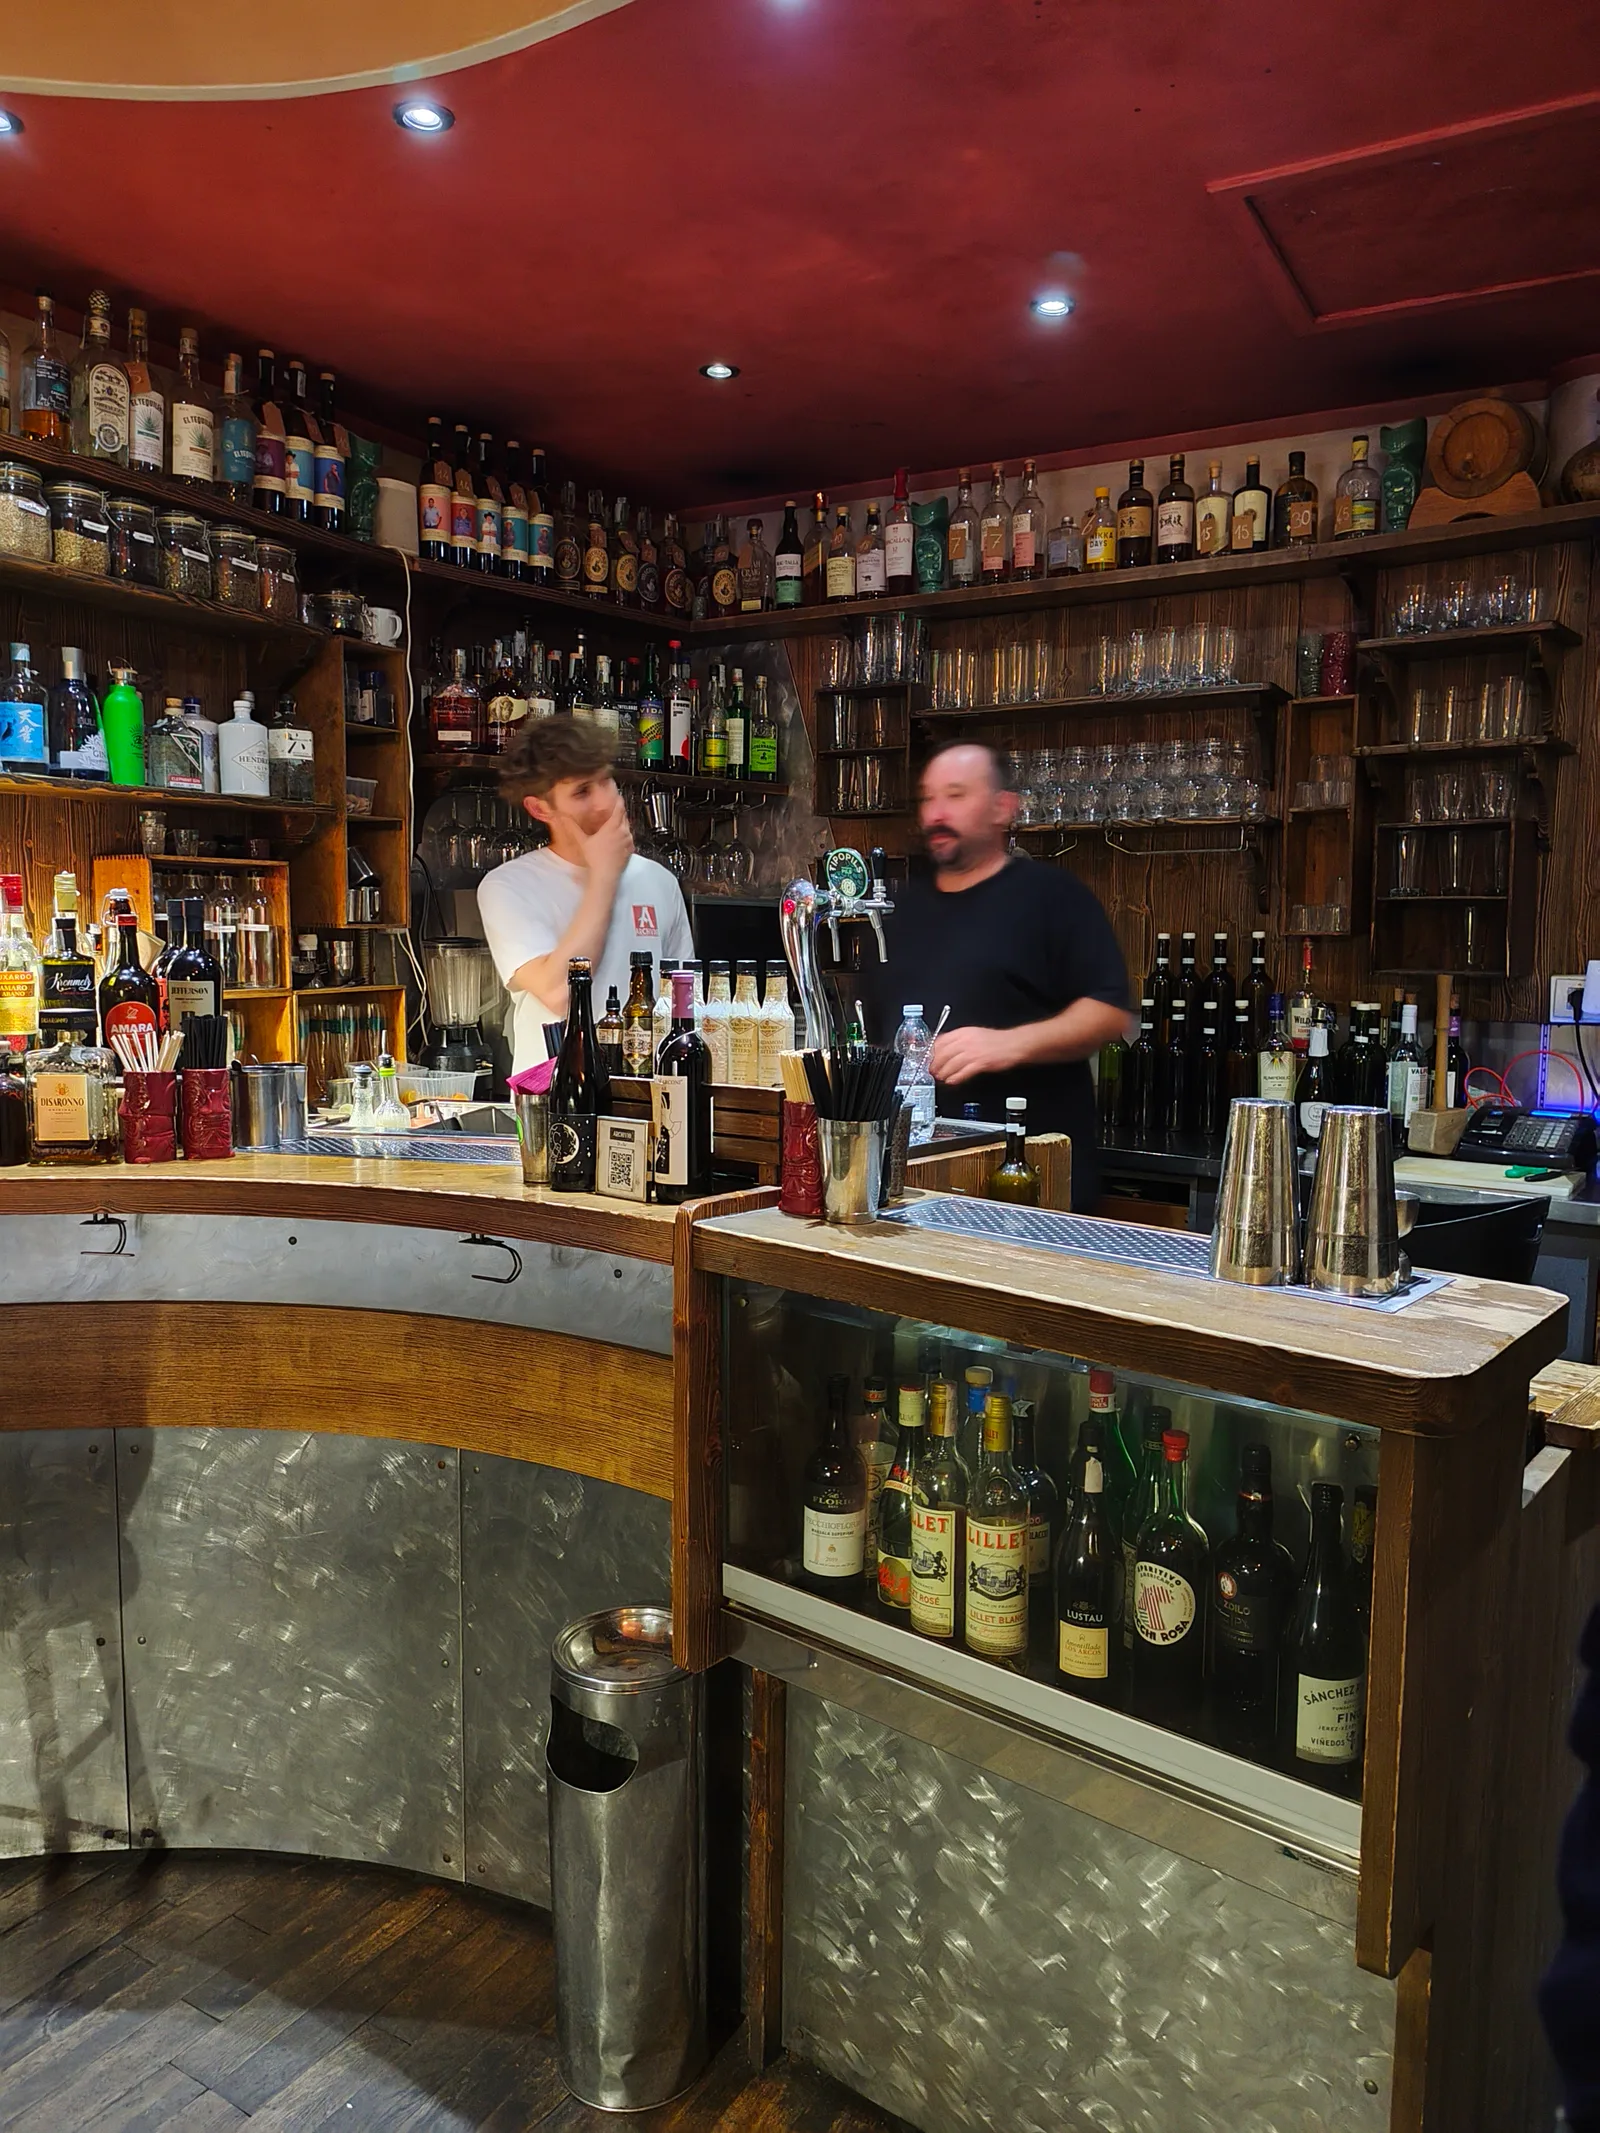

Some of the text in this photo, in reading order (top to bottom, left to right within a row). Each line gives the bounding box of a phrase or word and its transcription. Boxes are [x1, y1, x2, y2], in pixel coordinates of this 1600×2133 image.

[1291, 510, 1311, 529] 30
[1234, 524, 1250, 540] 15
[951, 537, 961, 554] 7
[990, 533, 1003, 549] 7
[829, 852, 864, 874] TIPOPILS
[0, 984, 28, 992] AMARO
[171, 986, 209, 995] JEFFERSON
[110, 1022, 155, 1034] AMARA
[40, 1098, 85, 1107] DISARONNO
[813, 1495, 856, 1505] FLORIO
[968, 1526, 1027, 1550] LILLET
[919, 1594, 940, 1606] ROSÉ
[970, 1609, 1024, 1625] LILLET BLANC
[1066, 1608, 1104, 1623] LUSTAU
[1160, 1619, 1190, 1642] ROSA
[1066, 1638, 1101, 1650] Amontillado
[1078, 1648, 1102, 1656] ARCOS
[1311, 1737, 1346, 1747] VIÑEDOS
